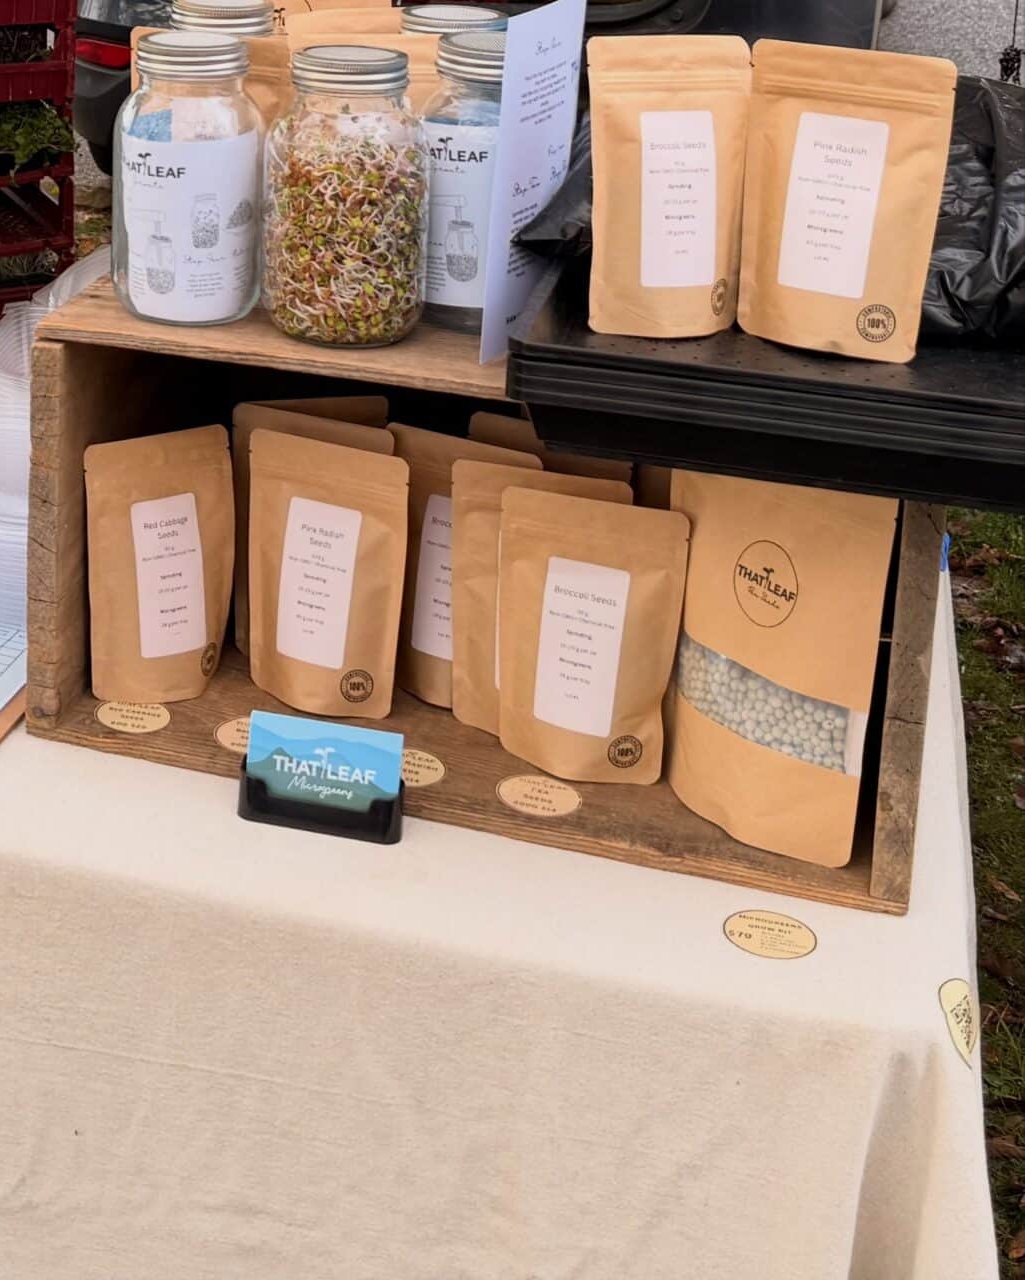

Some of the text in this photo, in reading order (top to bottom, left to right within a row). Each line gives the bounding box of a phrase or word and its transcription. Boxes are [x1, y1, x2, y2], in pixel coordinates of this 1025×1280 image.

[449, 149, 488, 163] LEAF
[823, 155, 853, 167] Seeds
[148, 165, 186, 179] LEAF
[867, 317, 886, 329] 100%
[143, 516, 188, 530] Red Cabbage
[157, 530, 179, 540] Seeds
[318, 527, 344, 539] Radish
[309, 537, 332, 549] Seeds
[738, 563, 766, 587] THAT
[767, 580, 797, 602] LEAF
[554, 585, 617, 607] Broccoli Seeds
[273, 755, 377, 785] THAT LEAF
[287, 775, 353, 800] Microgreens
